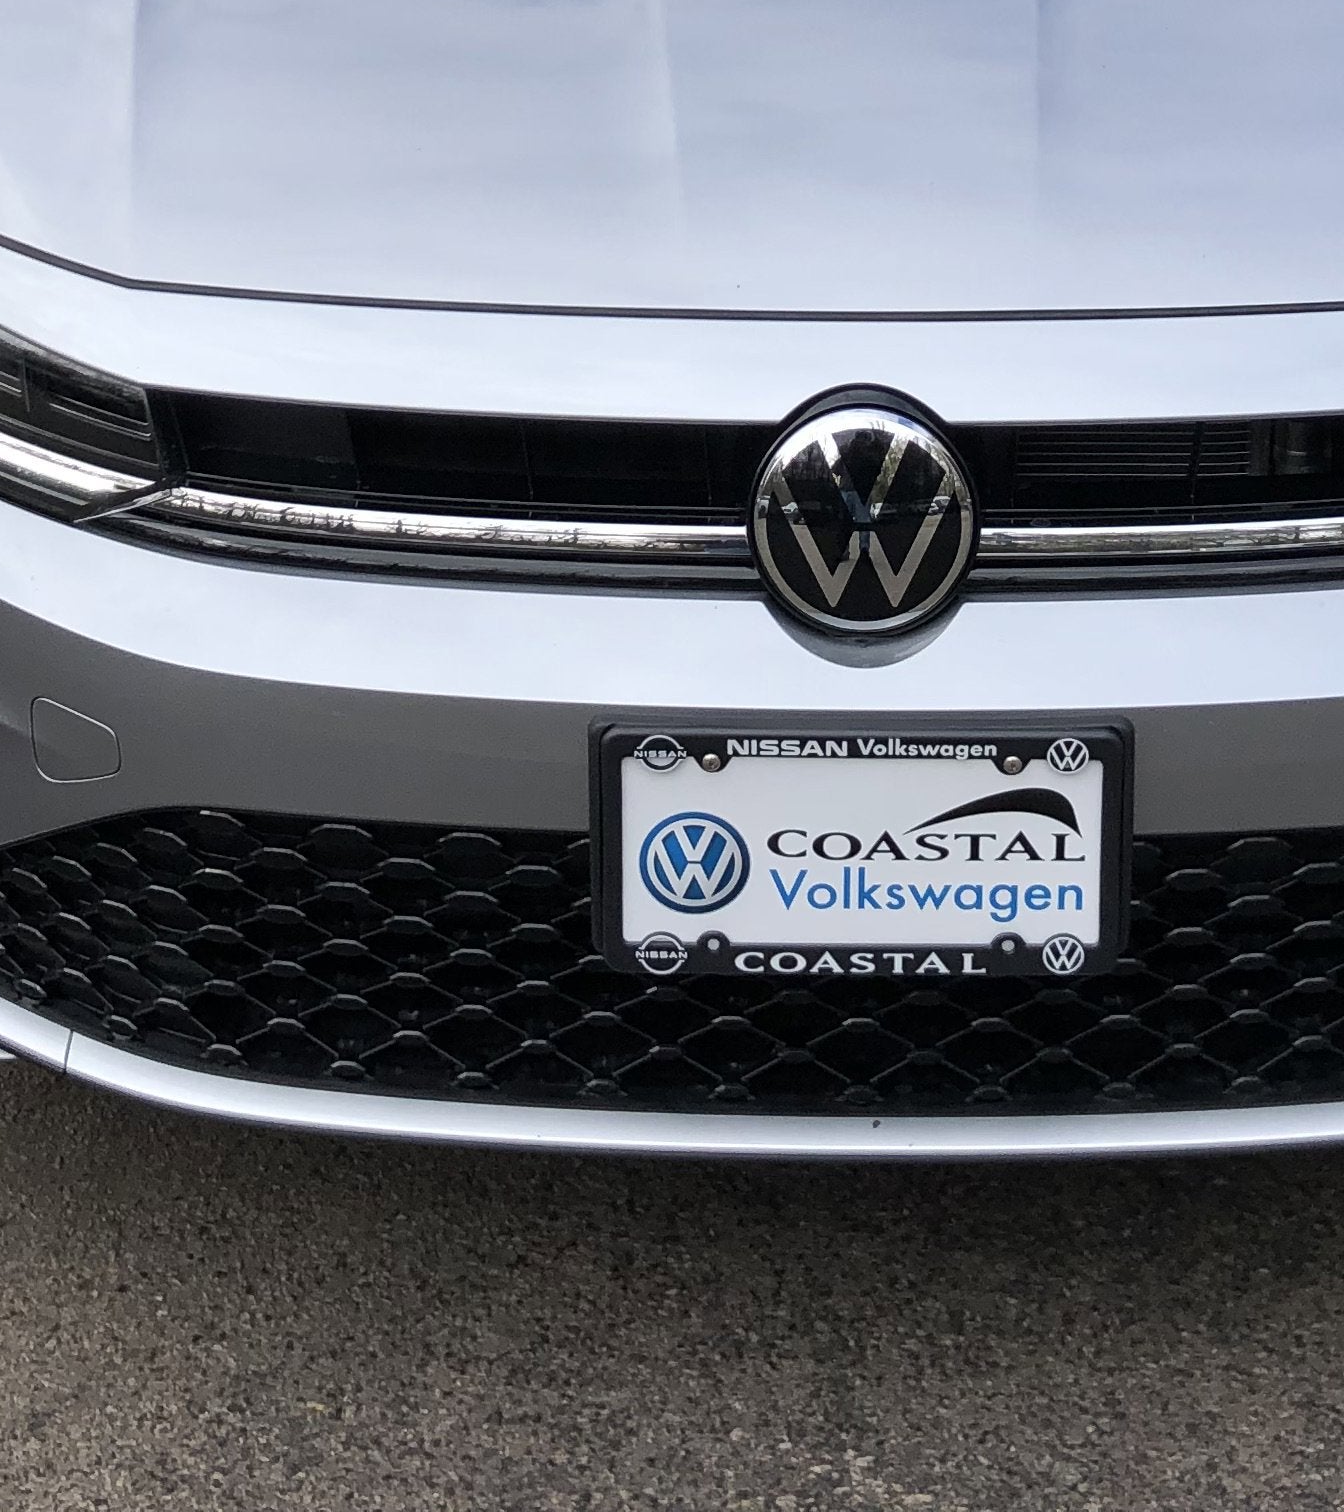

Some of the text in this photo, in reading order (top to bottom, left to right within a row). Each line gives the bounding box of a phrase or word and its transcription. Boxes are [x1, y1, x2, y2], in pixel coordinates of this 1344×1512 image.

[633, 748, 687, 759] NISSAN
[726, 737, 998, 760] NISSAN Volkswagen
[766, 828, 1086, 862] COASTAL
[768, 866, 1084, 922] Volkswagen
[634, 950, 688, 961] NISSAN
[734, 951, 987, 975] COASTAL
